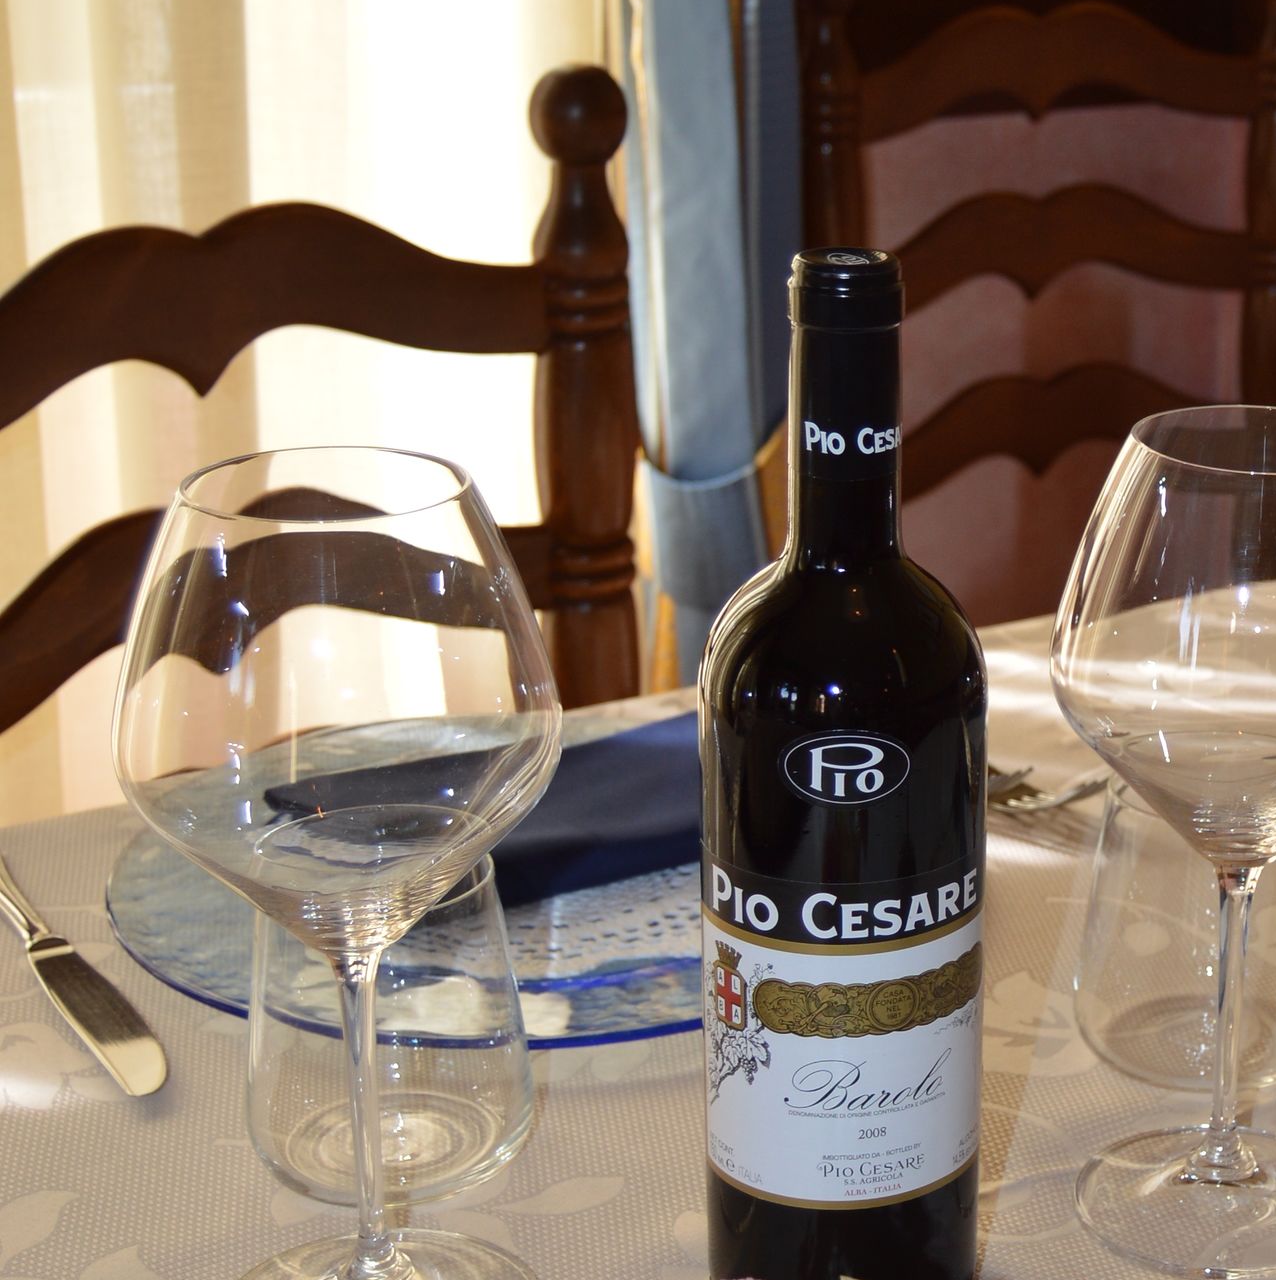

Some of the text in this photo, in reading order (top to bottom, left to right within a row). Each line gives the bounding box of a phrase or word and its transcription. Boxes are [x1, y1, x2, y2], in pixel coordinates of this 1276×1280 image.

[804, 421, 903, 455] PIO CESA
[711, 863, 977, 939] PIO CESARE
[883, 989, 904, 999] CASA
[783, 1047, 952, 1111] Barolo
[858, 1126, 887, 1140] 2008
[816, 1153, 926, 1178] PIO CESARE
[860, 1172, 904, 1186] AGRICOLA
[844, 1188, 868, 1197] ALBA
[873, 1183, 903, 1195] ITALIA
